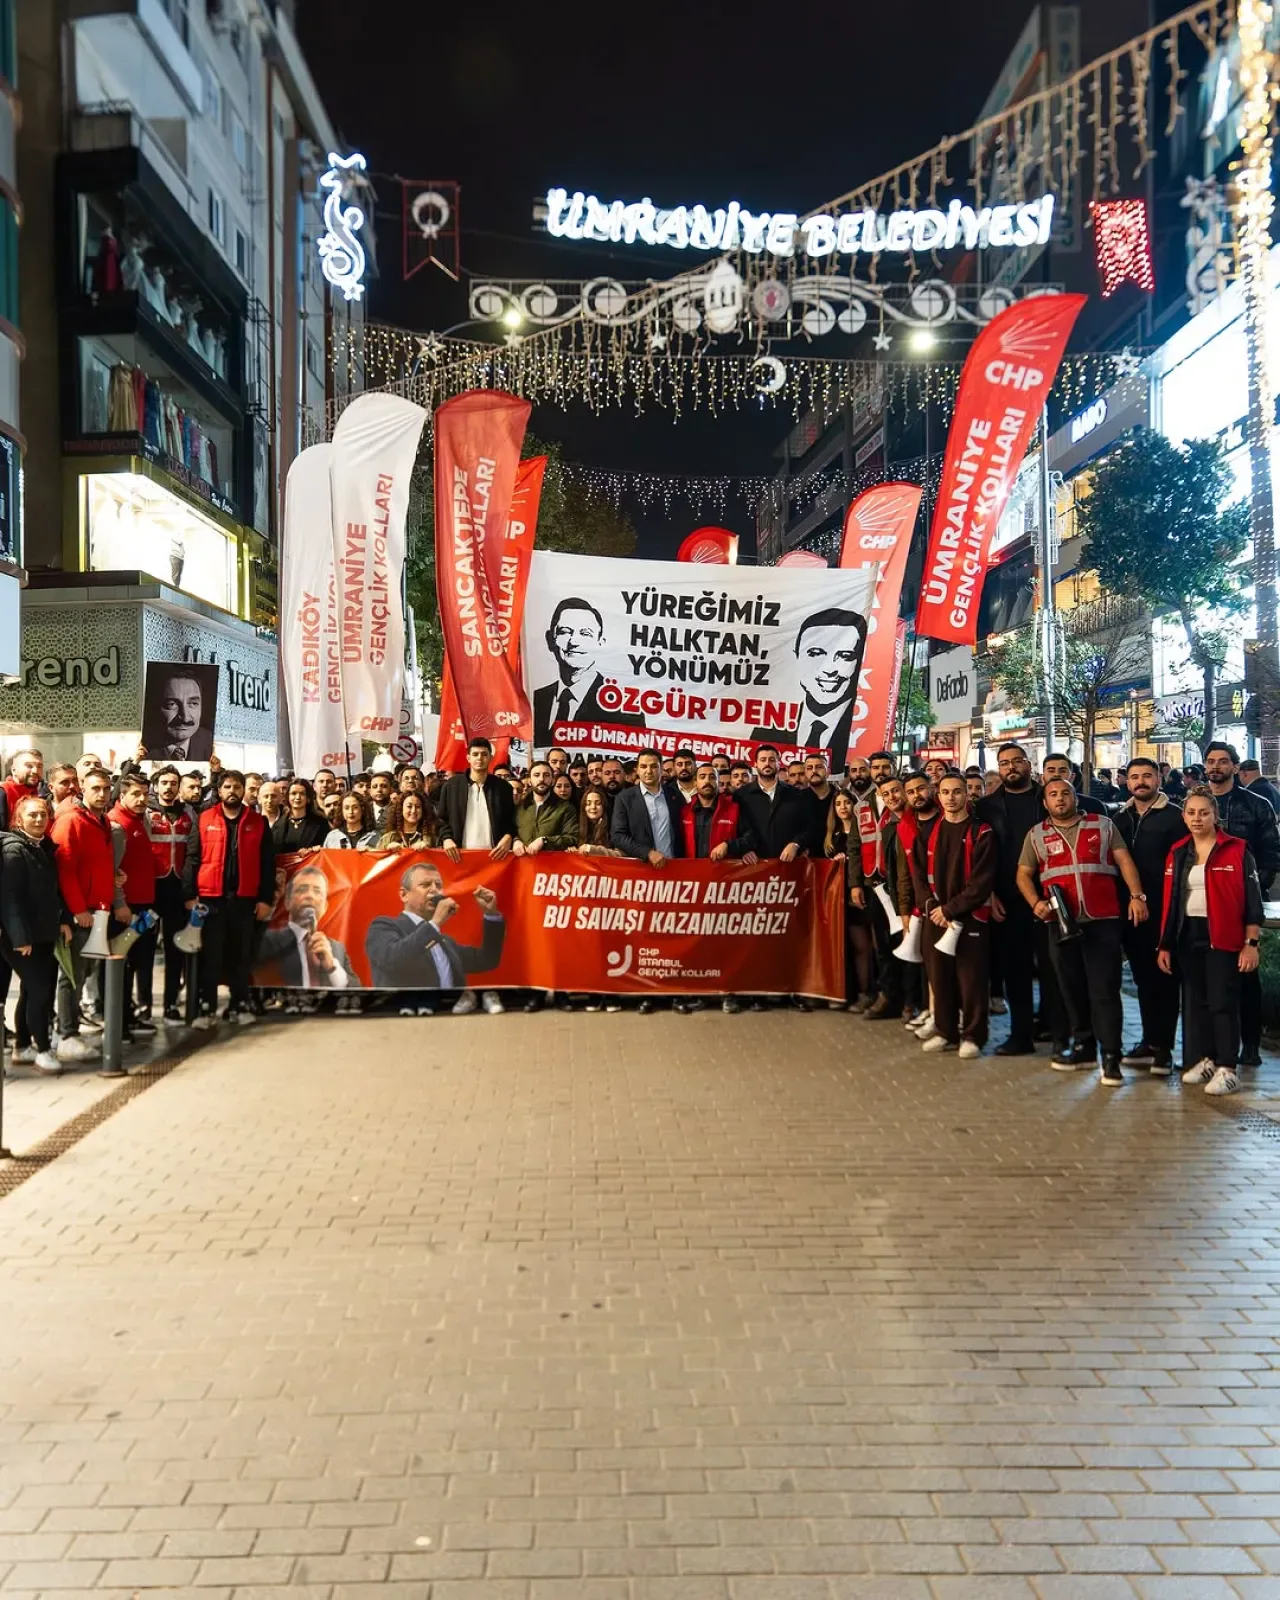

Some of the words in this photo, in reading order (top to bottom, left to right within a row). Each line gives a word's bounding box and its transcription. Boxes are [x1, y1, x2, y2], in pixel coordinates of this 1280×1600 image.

[547, 188, 797, 257] ÜMRANİYE
[801, 194, 1055, 257] BELEDİYESİ
[985, 361, 1043, 391] CHP
[475, 457, 496, 545] OLLARI
[922, 418, 992, 605] ÜMRANİYE
[949, 522, 986, 628] GENÇLİK
[974, 406, 1027, 519] KOLLARI
[374, 473, 393, 568] KOLLARI
[859, 535, 897, 549] CHP
[454, 465, 483, 657] SANCAKTEPE
[368, 574, 391, 666] GENÇLİK
[621, 586, 781, 626] YÜREĞİMİZ
[297, 591, 320, 702] KADIKÖY
[630, 624, 769, 659] HALKTAN,
[20, 645, 120, 687] rend
[628, 650, 770, 685] YÖNÜMÜZ
[227, 660, 270, 711] Trend
[495, 711, 520, 726] CHP
[597, 677, 799, 732] ÖZGÜR'DEN!
[360, 716, 394, 731] CHP
[555, 727, 586, 742] CHP
[591, 724, 675, 751] ÜMRANİYE
[322, 753, 356, 767] CHP
[532, 873, 699, 904] BAŞKANLARIMIZI
[703, 876, 799, 907] ALACAĞIZ,
[543, 905, 571, 929] BU
[575, 906, 645, 935] SAVAŞI
[649, 907, 790, 935] KAZANACAĞIZ!
[638, 948, 660, 956] CHP
[638, 957, 683, 968] İSTANBUL
[638, 967, 679, 979] GENÇLİK
[681, 969, 721, 978] KOLLARI
